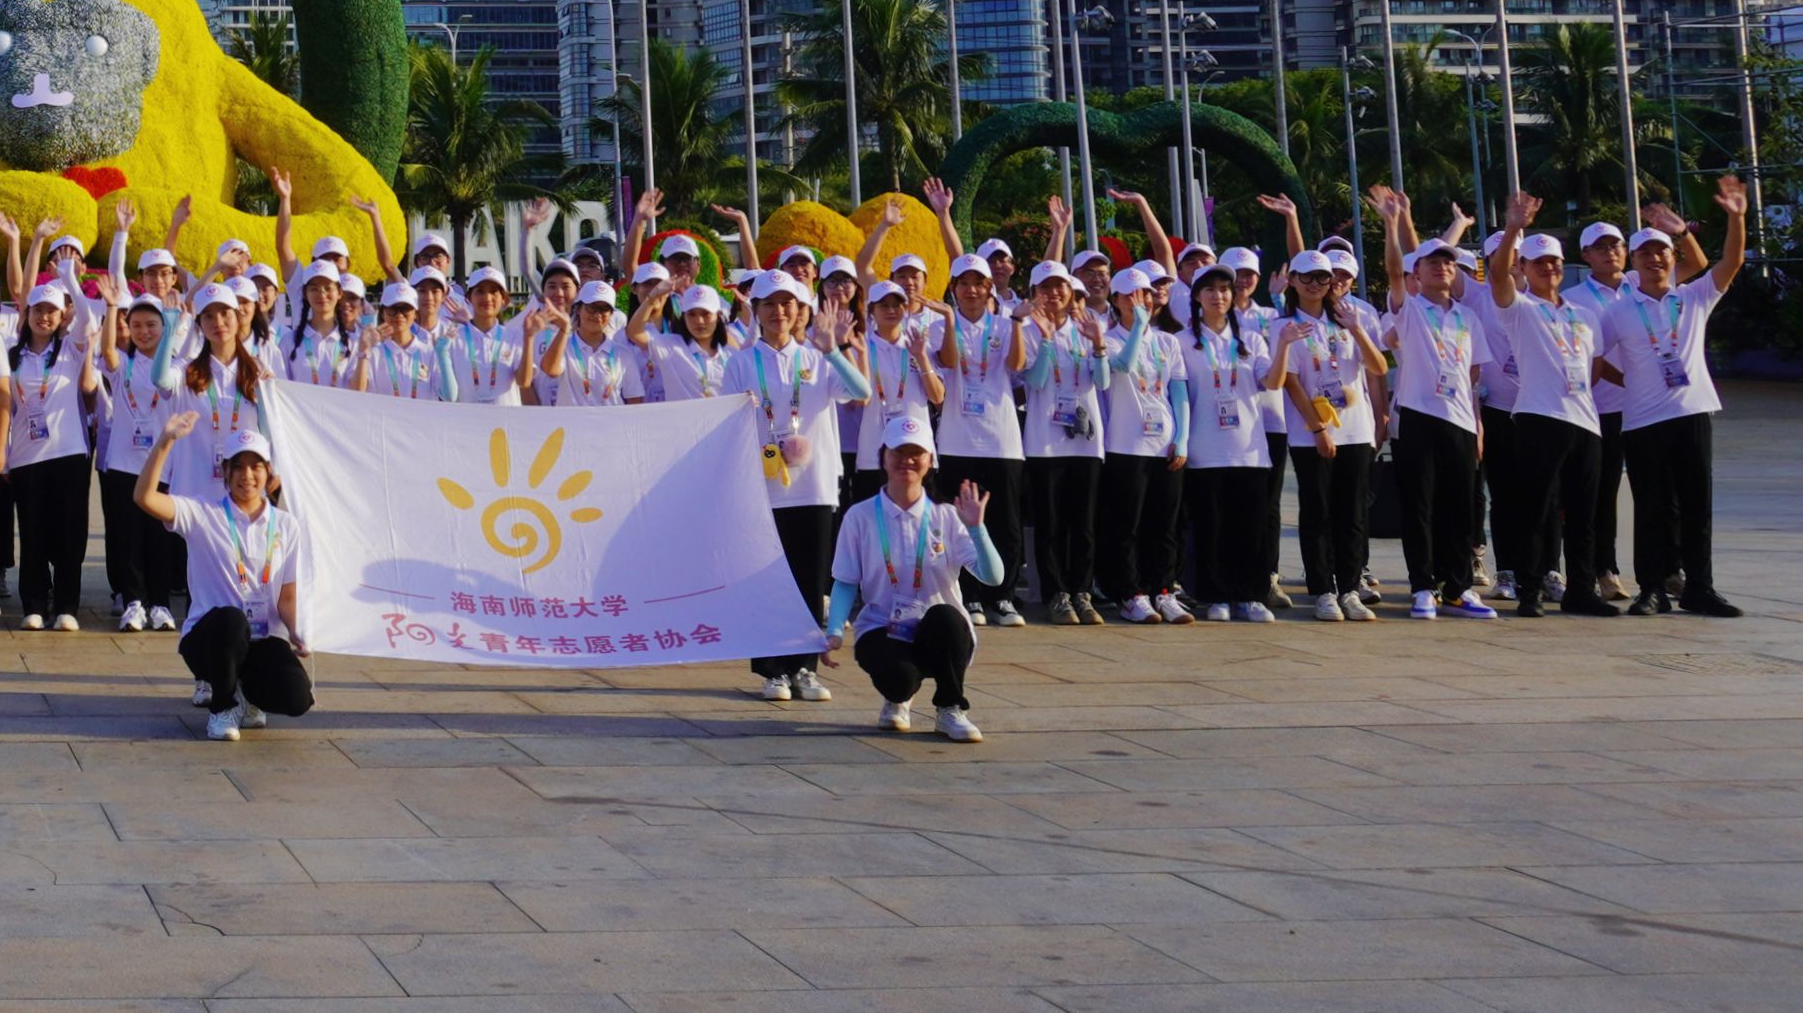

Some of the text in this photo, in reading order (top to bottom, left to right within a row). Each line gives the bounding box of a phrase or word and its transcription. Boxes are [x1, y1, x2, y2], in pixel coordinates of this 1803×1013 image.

[450, 591, 629, 618] 海南师范大学
